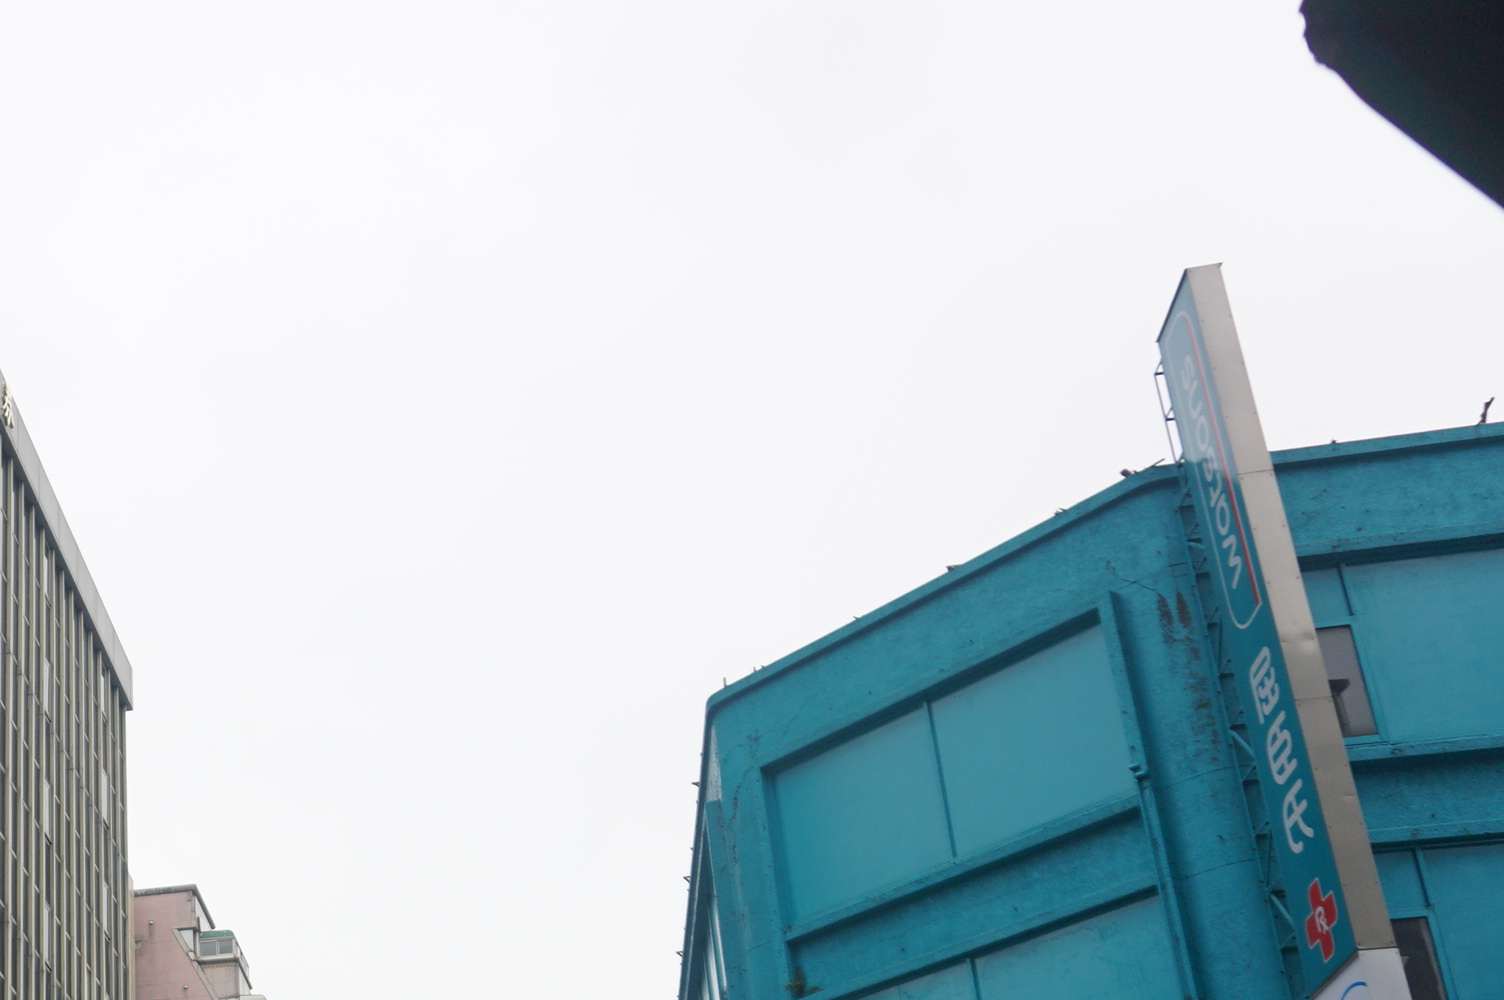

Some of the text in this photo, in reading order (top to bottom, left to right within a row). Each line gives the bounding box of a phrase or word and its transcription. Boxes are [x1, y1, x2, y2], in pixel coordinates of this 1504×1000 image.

[1179, 353, 1243, 591] watsons
[1249, 646, 1317, 857] 屈臣氏
